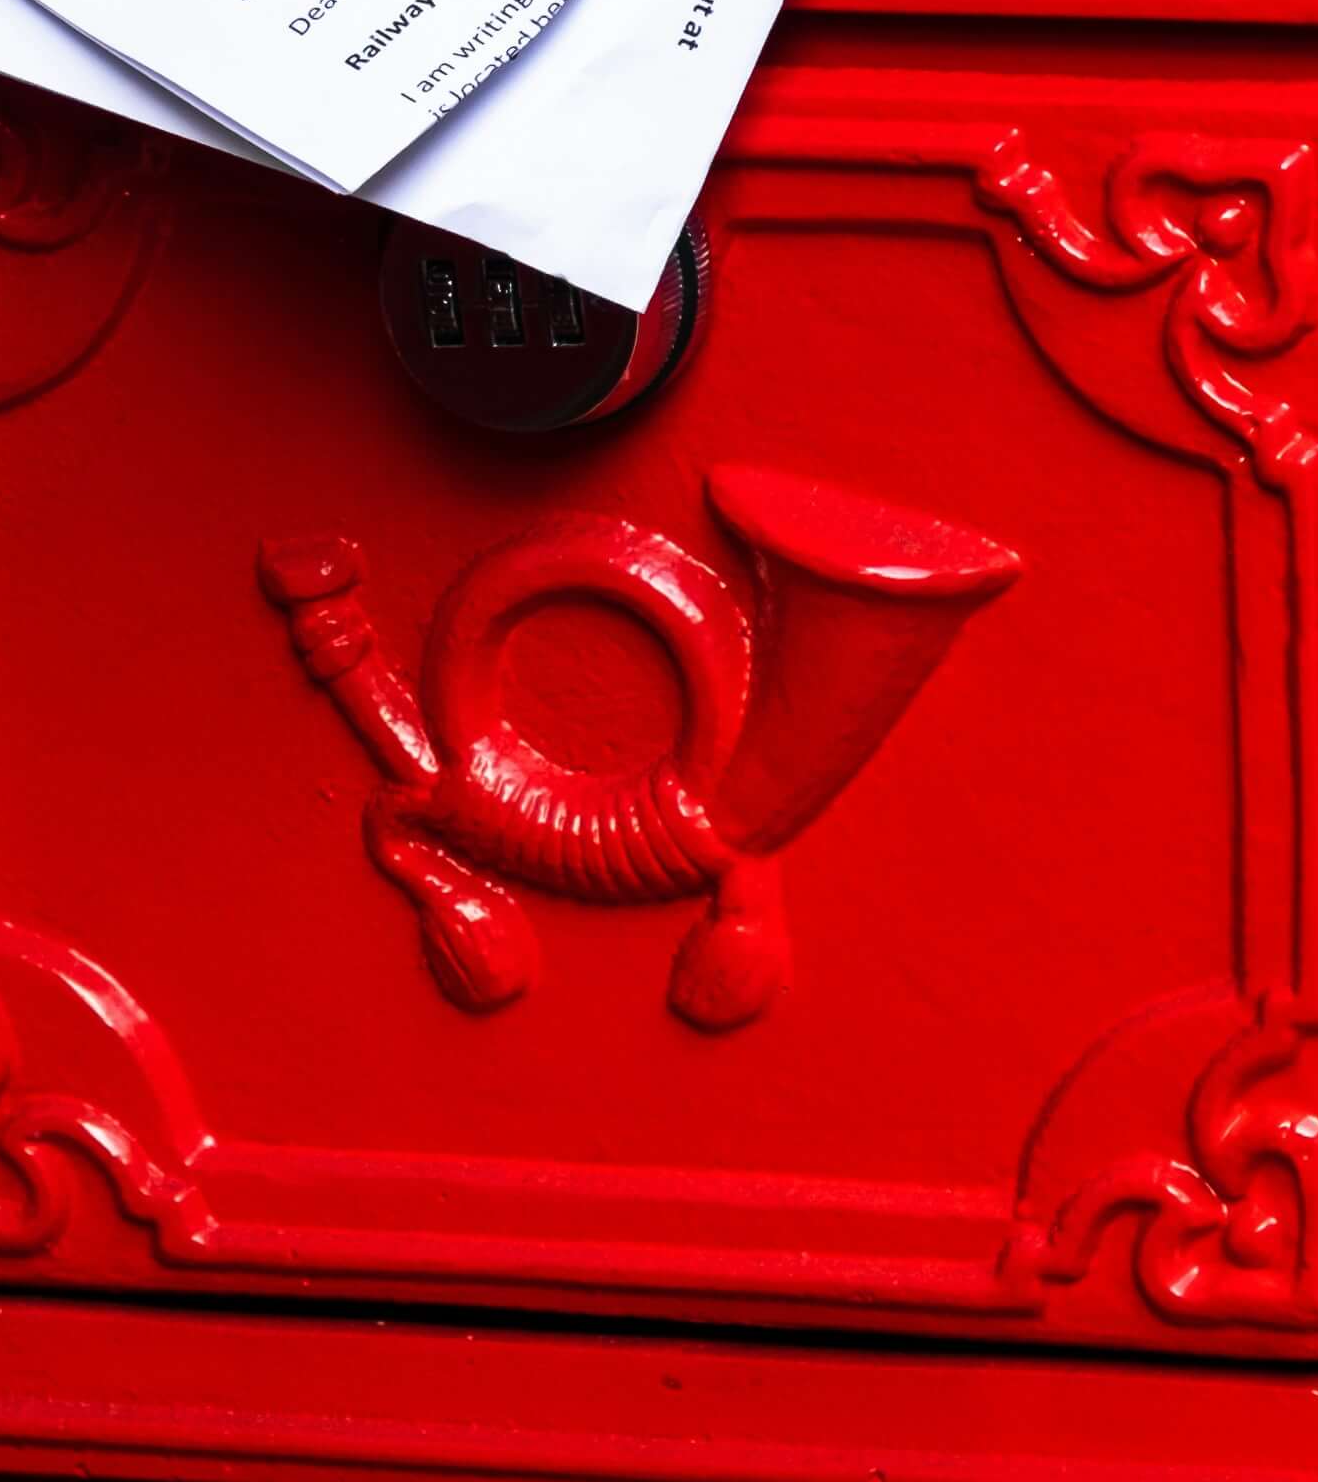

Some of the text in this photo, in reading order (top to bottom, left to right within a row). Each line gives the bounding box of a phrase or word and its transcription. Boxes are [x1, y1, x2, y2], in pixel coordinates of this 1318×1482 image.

[676, 22, 704, 52] at
[400, 91, 417, 104] I
[416, 61, 455, 95] am
